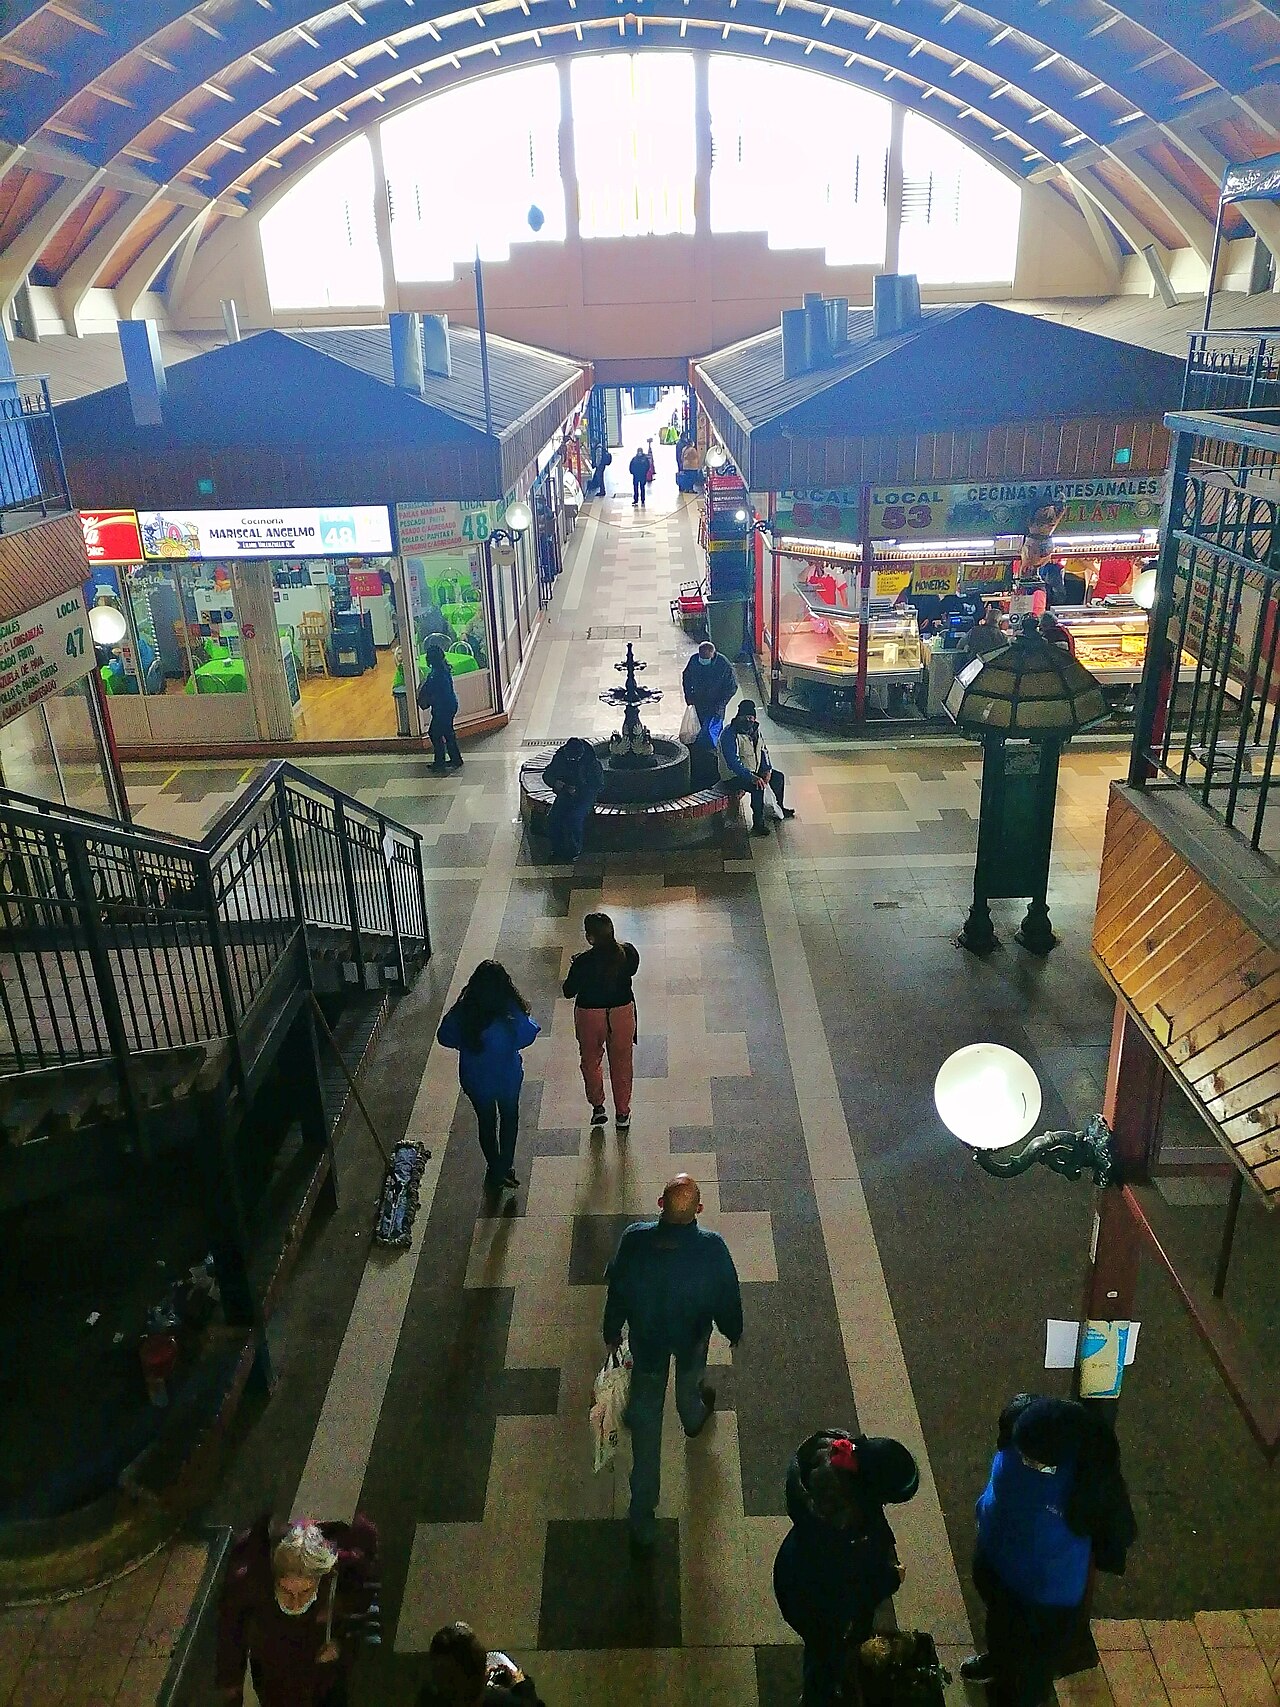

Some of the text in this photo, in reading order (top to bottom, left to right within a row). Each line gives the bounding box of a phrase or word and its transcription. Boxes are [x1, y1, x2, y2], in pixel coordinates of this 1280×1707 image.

[781, 489, 855, 505] LOCAL
[873, 491, 944, 505] LOCAL
[967, 480, 1157, 502] CECINAS ARTESANALES
[420, 506, 446, 516] MARINAS
[460, 500, 488, 511] LOCAL
[400, 518, 426, 528] PESCADO
[792, 502, 841, 531] 53
[881, 504, 933, 530] 53
[209, 526, 315, 539] MARISCAL ANGELMO
[401, 526, 421, 536] ASADO
[462, 512, 489, 541] 48
[324, 526, 354, 546] 48
[56, 598, 81, 619] LOCAL
[0, 620, 20, 639] CALES
[66, 625, 85, 658] 47
[21, 663, 29, 677] DE
